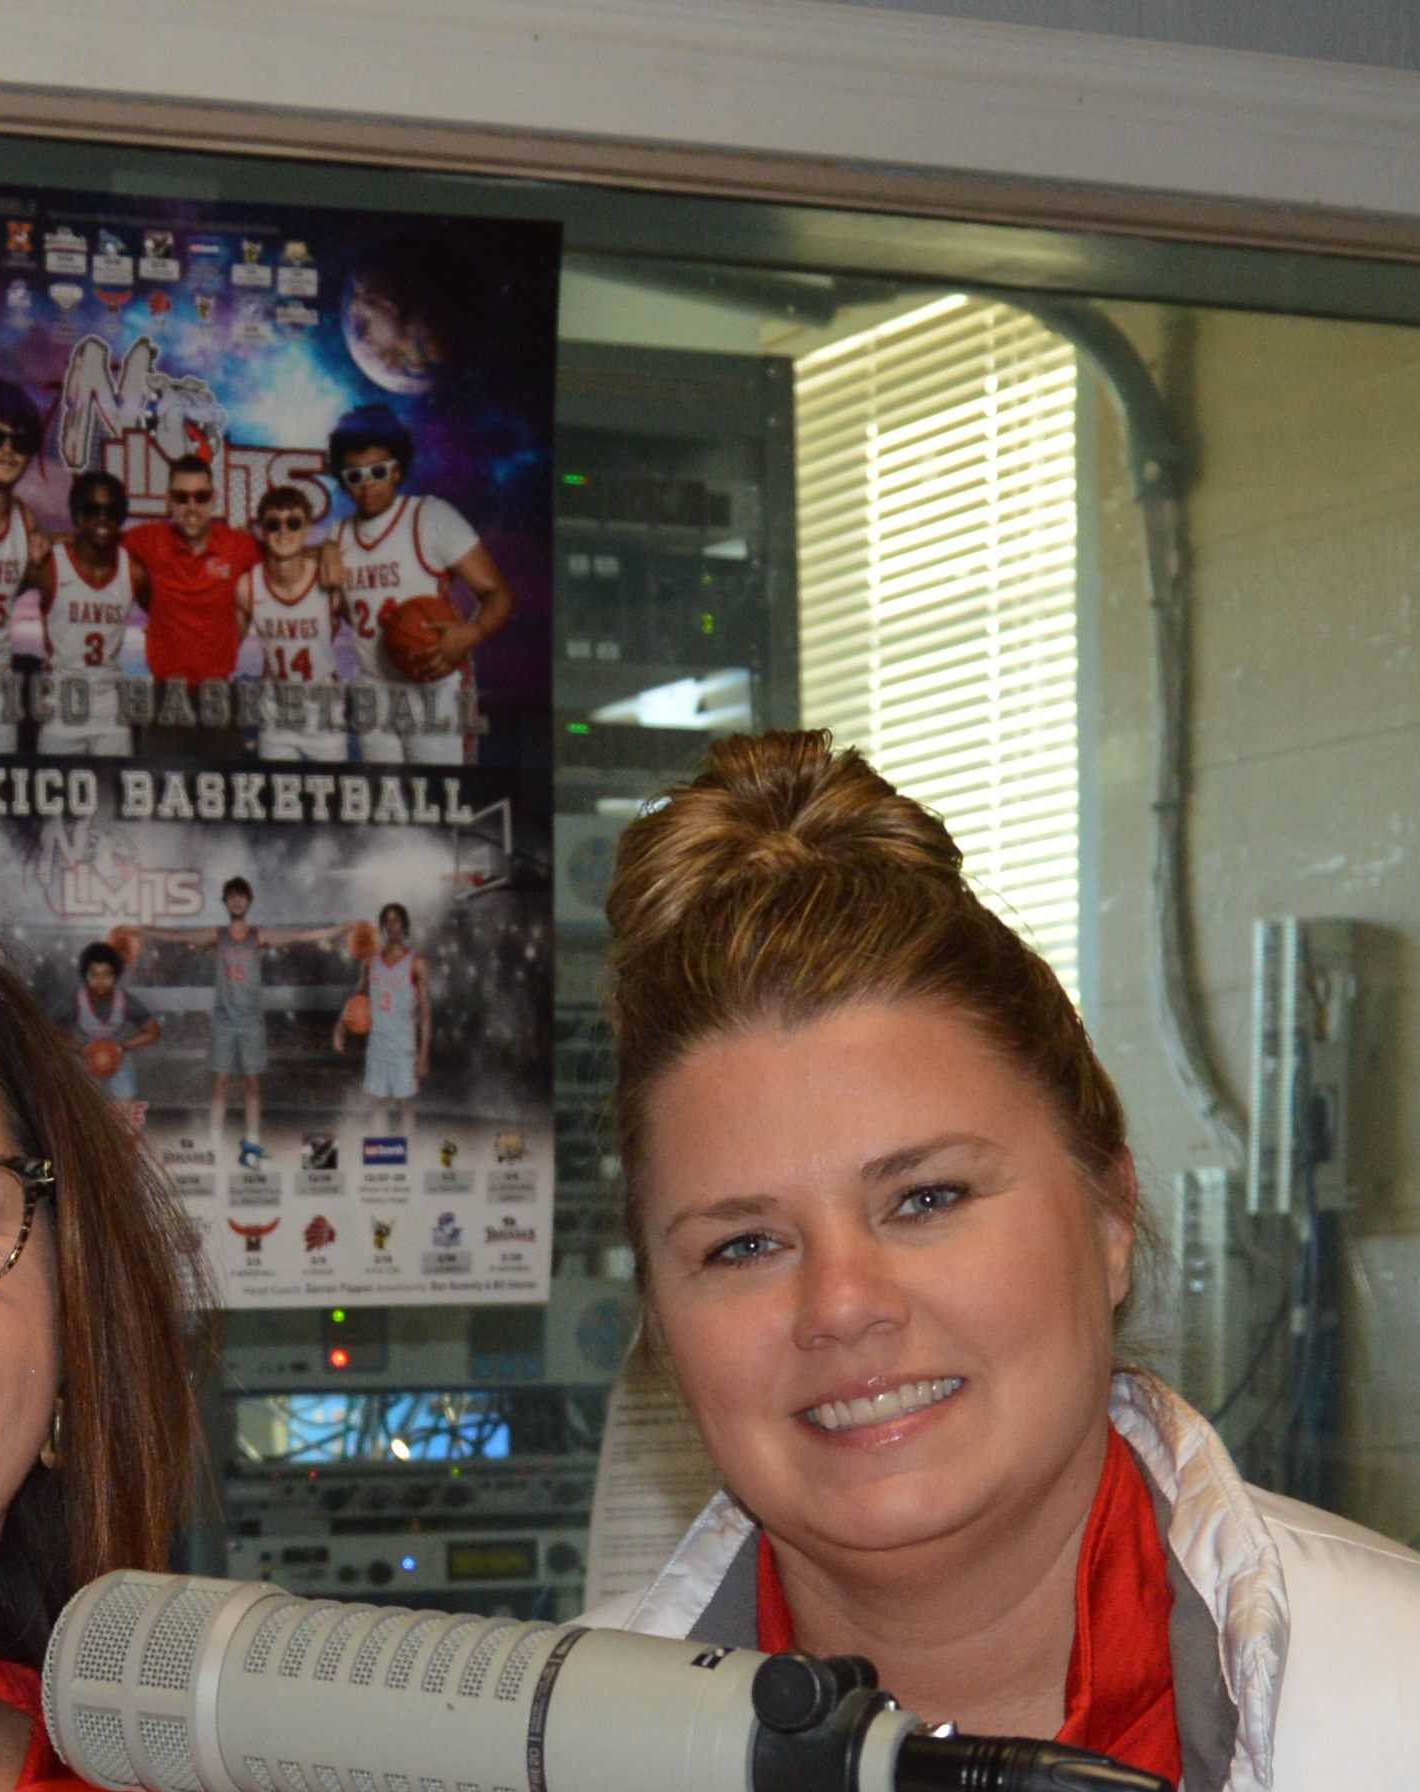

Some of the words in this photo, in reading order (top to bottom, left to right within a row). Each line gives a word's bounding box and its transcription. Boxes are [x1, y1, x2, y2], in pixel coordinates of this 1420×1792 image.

[69, 601, 123, 625] DAWGS
[264, 616, 318, 641] DAWGS
[85, 632, 104, 667] 3
[275, 647, 311, 680] 14
[120, 677, 488, 734] BASKETBALL
[122, 770, 472, 824] BASKETBALL
